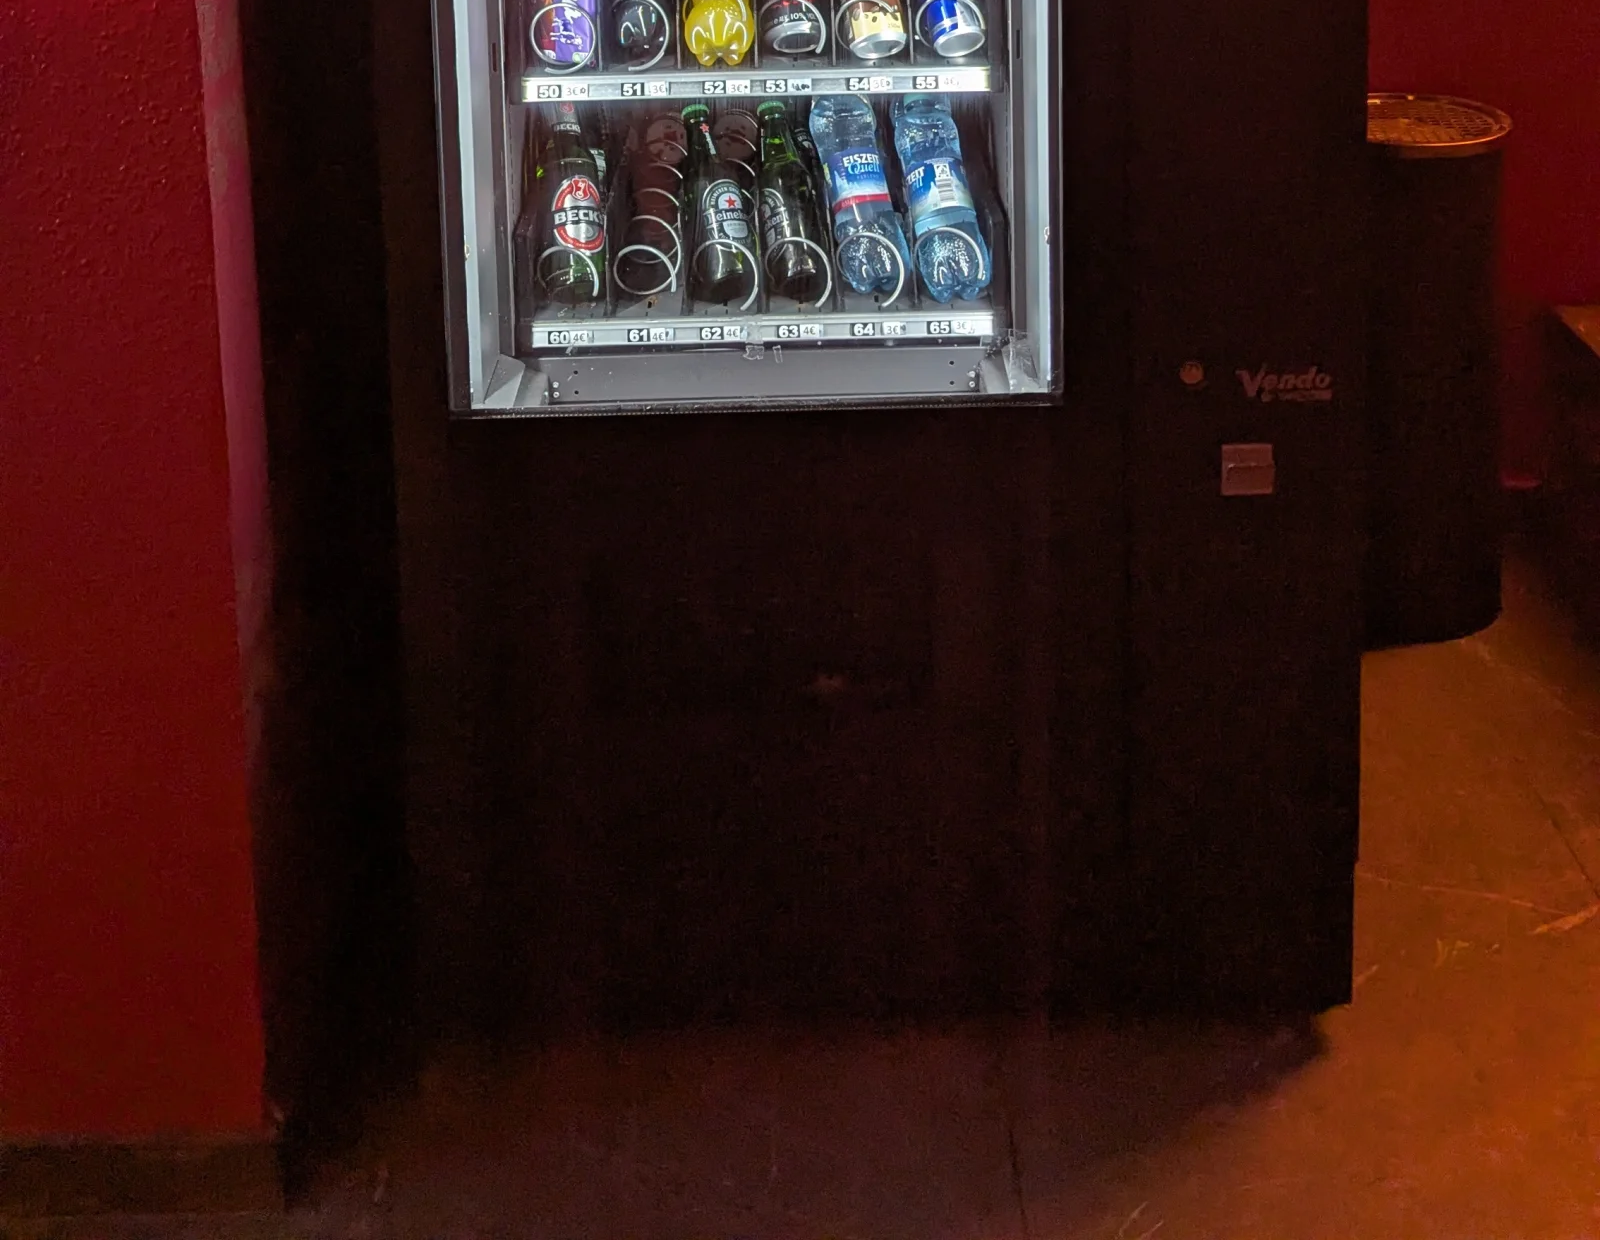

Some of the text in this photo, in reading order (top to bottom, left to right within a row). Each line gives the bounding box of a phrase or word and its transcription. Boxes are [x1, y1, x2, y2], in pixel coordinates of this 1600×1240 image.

[622, 83, 665, 96] 51 3€
[703, 81, 725, 94] 52
[765, 80, 786, 93] 53
[849, 78, 870, 91] 54
[915, 77, 936, 89] 55
[538, 85, 560, 98] 50
[843, 153, 880, 166] EISZEIT
[847, 161, 880, 174] Quell
[905, 166, 925, 184] ZEIT
[701, 327, 739, 340] 62 4€
[778, 325, 816, 338] 63 4€
[853, 323, 900, 336] 64 3€
[929, 321, 968, 334] 65 3€
[549, 331, 587, 344] 60 4€
[629, 329, 665, 342] 61 4€
[1235, 362, 1332, 398] Vendo
